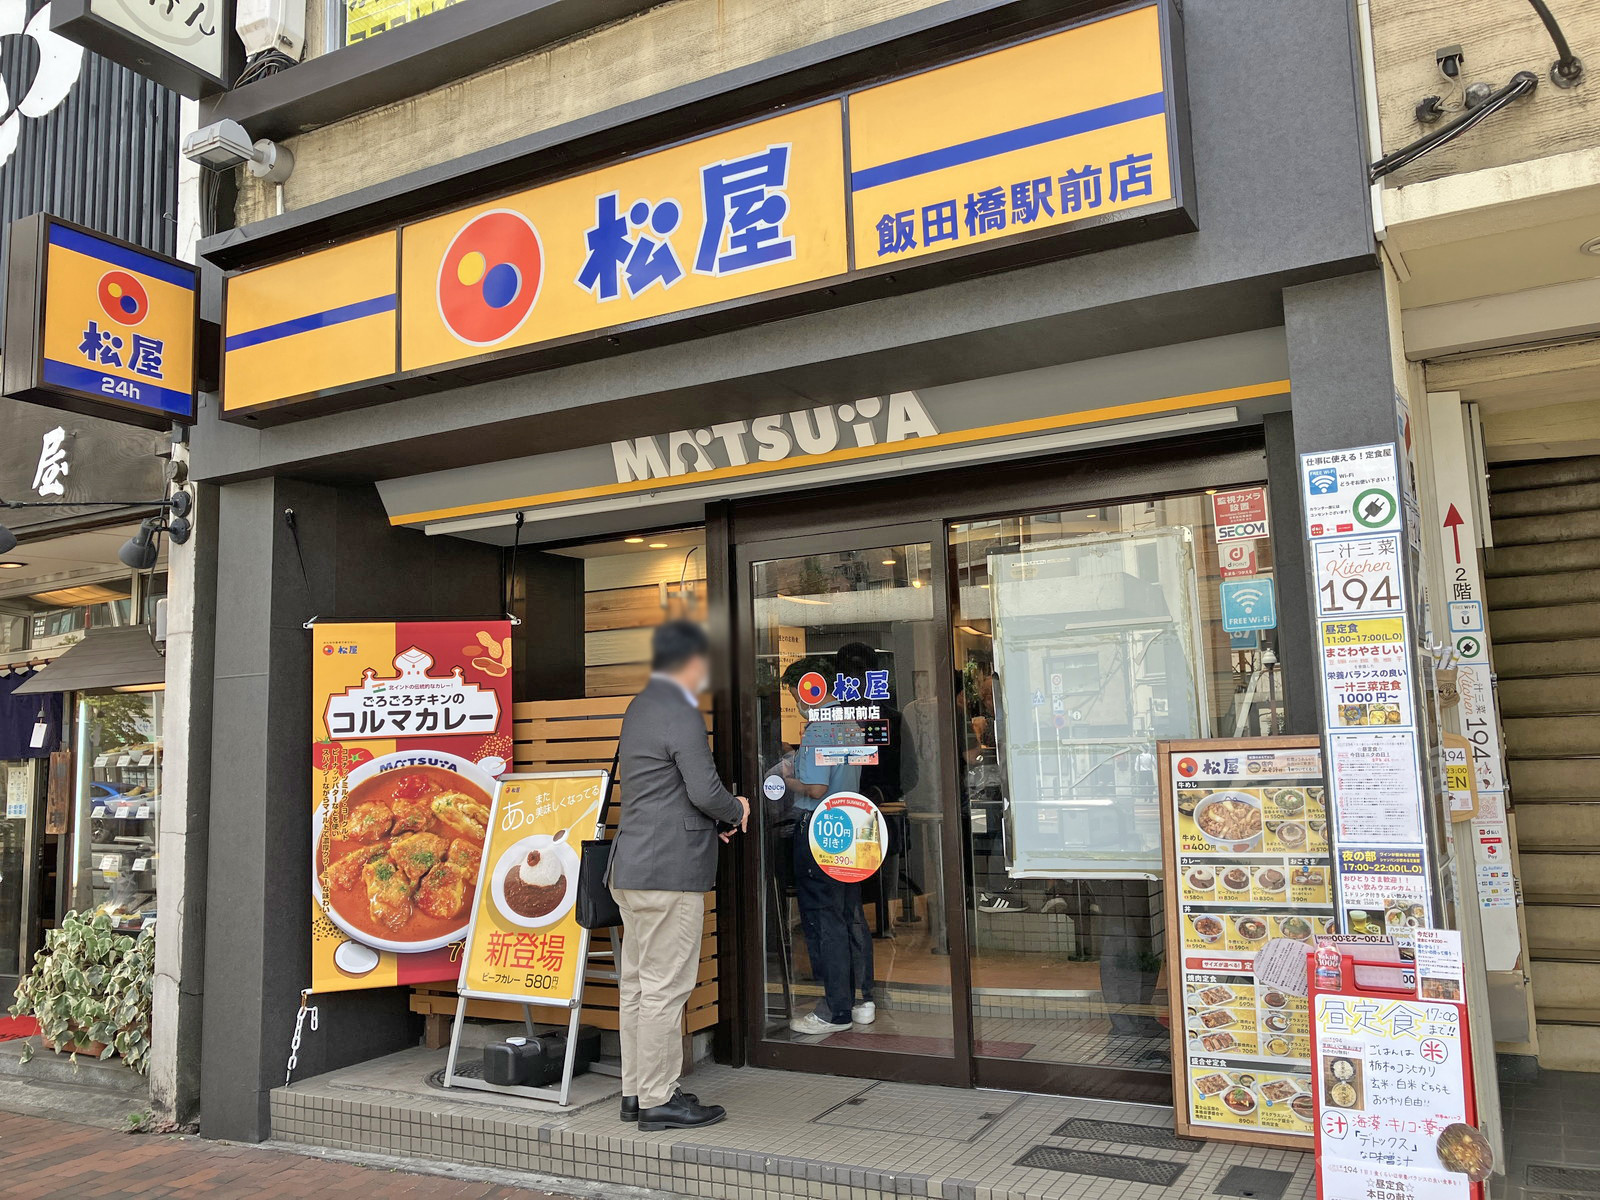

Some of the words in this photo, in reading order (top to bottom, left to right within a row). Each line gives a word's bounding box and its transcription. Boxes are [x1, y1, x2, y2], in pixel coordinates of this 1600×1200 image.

[876, 152, 1153, 256] 飯田橋駅前店
[573, 142, 796, 304] 松屋
[78, 320, 164, 380] 松屋
[101, 377, 140, 400] 24h
[32, 425, 69, 497] 屋
[1217, 492, 1261, 505] 監視カメラ
[1219, 522, 1266, 539] SECOM
[1318, 539, 1395, 559] 一汁三菜
[1326, 558, 1392, 579] Kitchen
[1321, 575, 1400, 613] 194
[1229, 617, 1248, 625] FREE
[1249, 615, 1270, 624] Wi-Fi
[1326, 645, 1404, 658] まごわやさしい
[832, 670, 891, 702] 松屋
[1334, 680, 1402, 693] 一汁三菜定食
[363, 693, 465, 707] ごろごろチキンの
[332, 707, 494, 734] コルマカレー
[808, 706, 880, 721] 飯田橋駅前店
[1466, 717, 1492, 763] 194
[1202, 758, 1240, 776] 松屋
[1342, 850, 1377, 862] 夜の部
[484, 930, 565, 972] 新登場
[482, 972, 520, 984] ビーフカレー
[1320, 1000, 1424, 1038] 昼定食
[1423, 1040, 1443, 1061] 米
[1326, 1116, 1347, 1134] 汁
